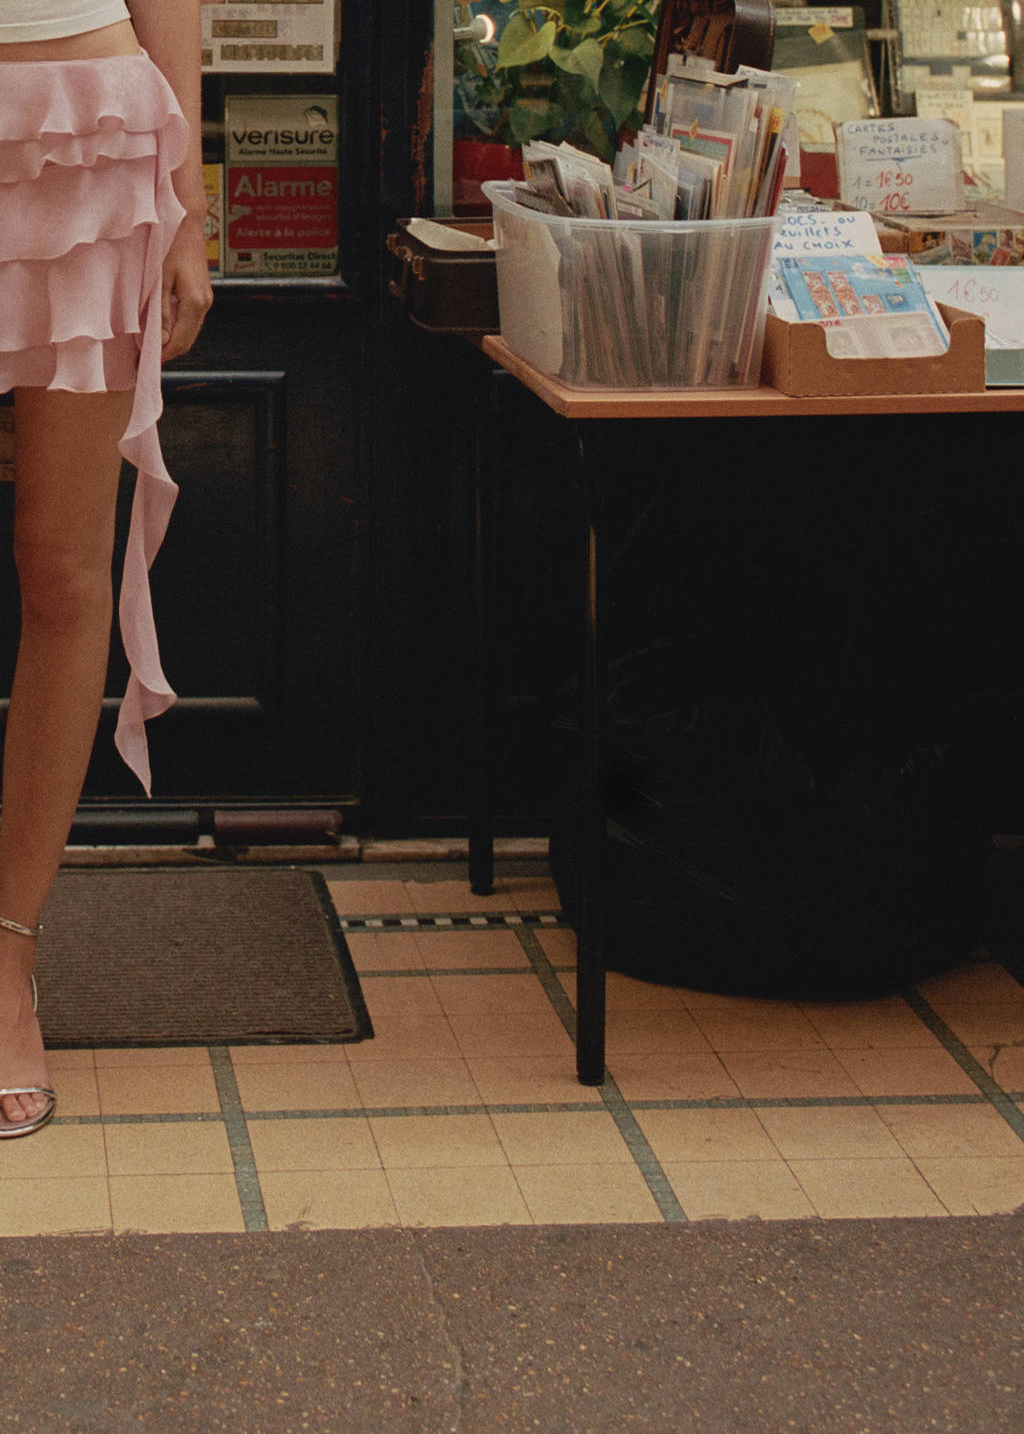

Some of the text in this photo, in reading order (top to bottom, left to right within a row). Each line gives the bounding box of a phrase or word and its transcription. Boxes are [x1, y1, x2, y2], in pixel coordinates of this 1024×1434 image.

[847, 123, 895, 135] CARTES
[232, 129, 335, 146] verisure
[873, 132, 939, 144] POSTALES
[233, 173, 333, 198] Alarme
[879, 191, 911, 213] 10€
[235, 226, 271, 237] Alerte
[298, 227, 331, 239] police
[779, 226, 842, 238] euillets
[774, 241, 795, 250] AU
